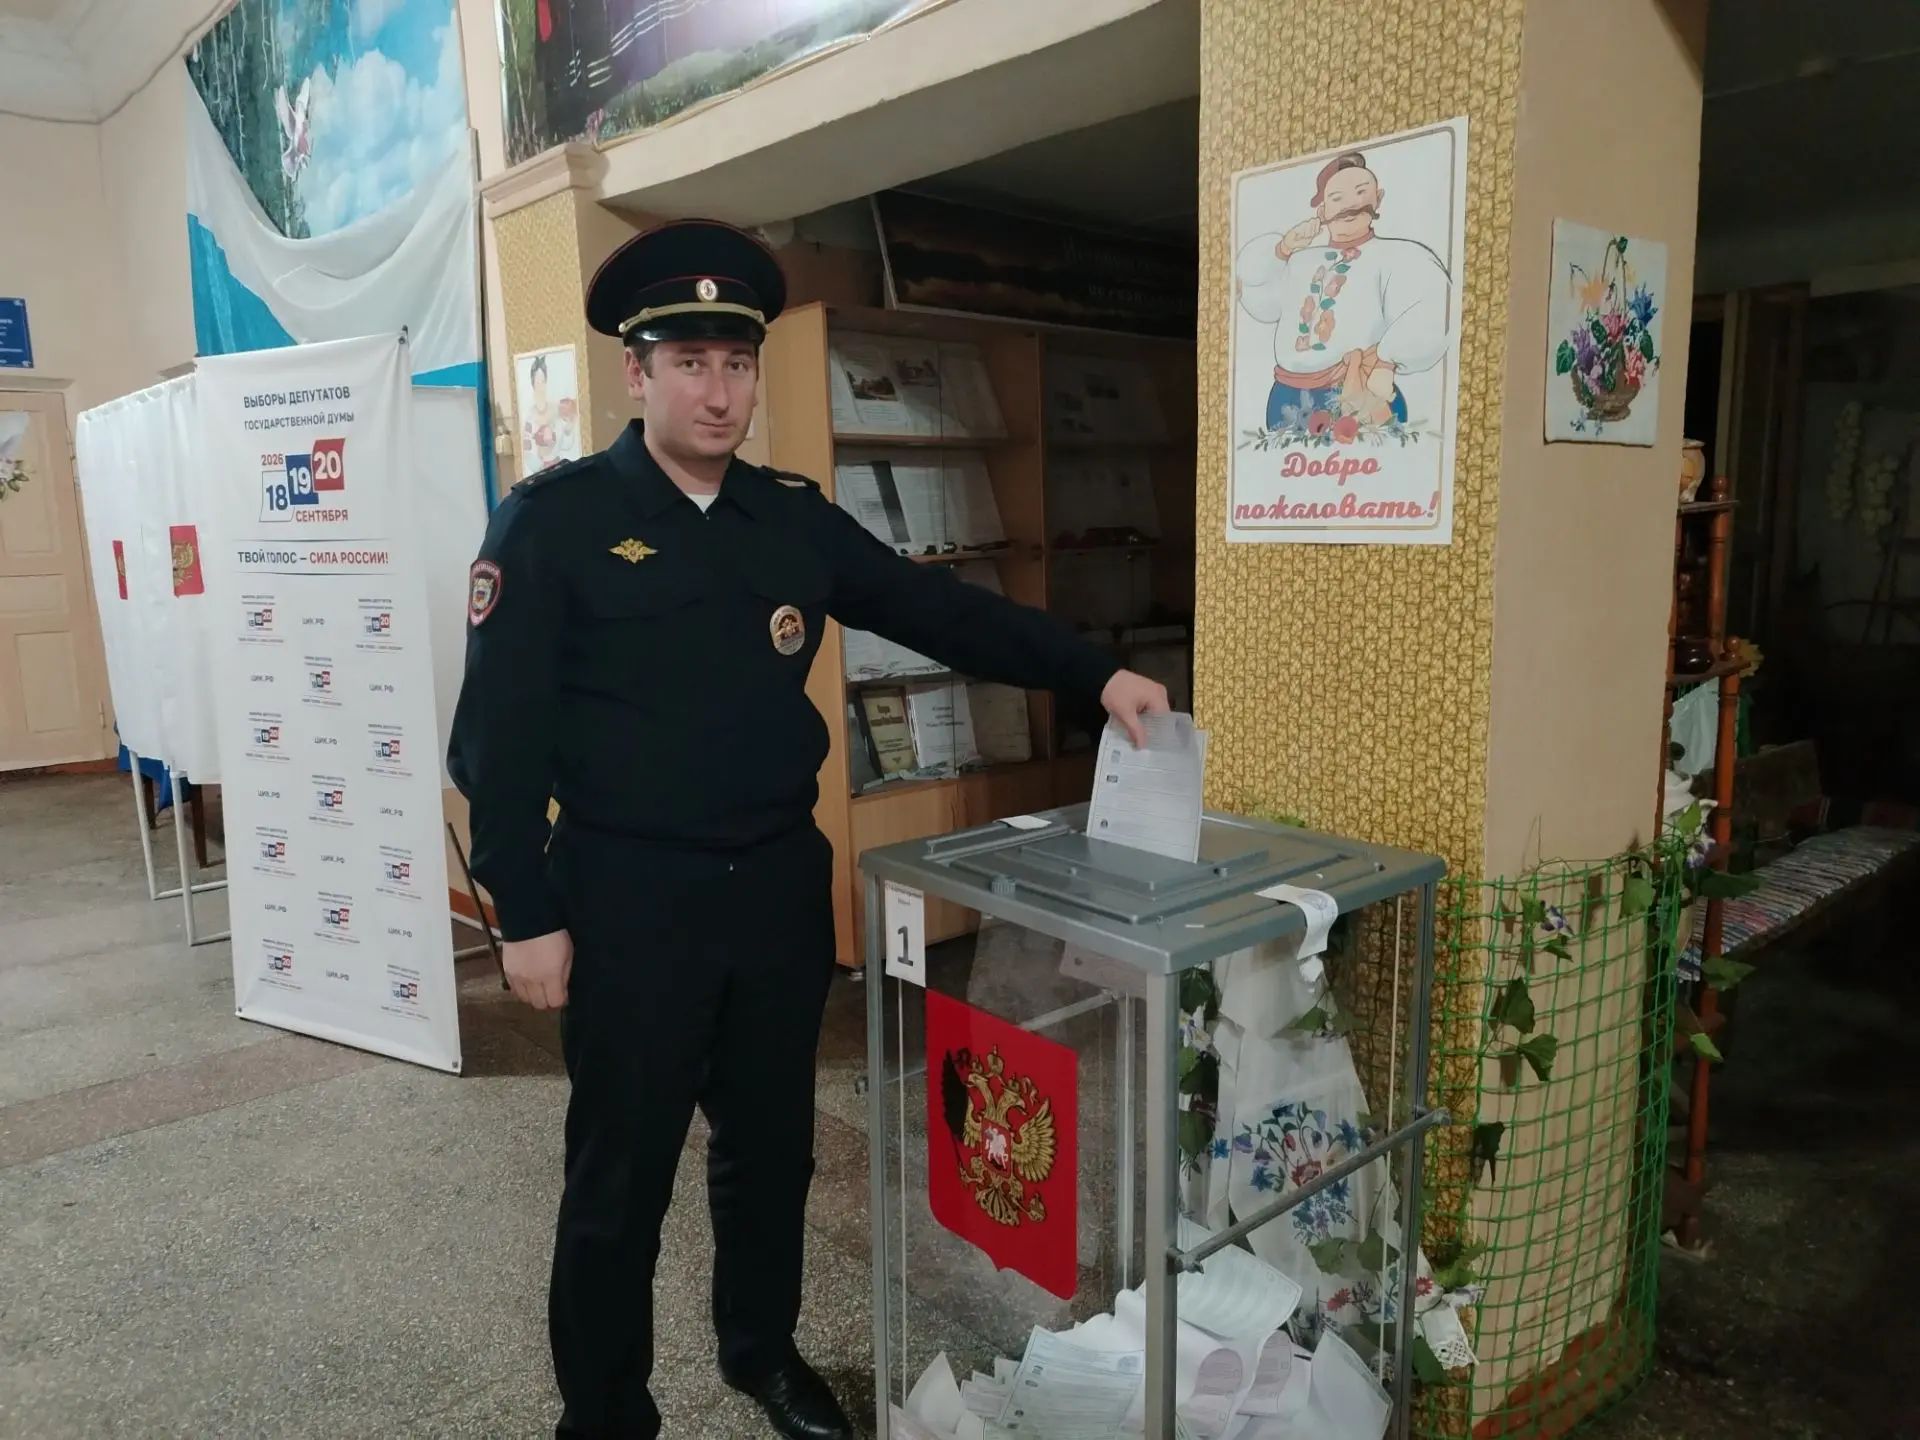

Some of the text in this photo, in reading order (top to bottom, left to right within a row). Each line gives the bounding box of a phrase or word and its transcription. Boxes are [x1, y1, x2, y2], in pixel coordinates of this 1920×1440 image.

[244, 386, 351, 408] ВЫБОРЫ ДЕПУТАТОВ
[244, 412, 355, 430] ГОСУДАРСТВЕННОЙ ДУМЫ
[261, 453, 284, 466] 2026
[313, 450, 342, 480] 20
[1280, 450, 1382, 486] Добро
[289, 466, 312, 495] 19
[265, 484, 288, 511] 18
[1235, 491, 1440, 520] пожаловать!
[295, 509, 348, 522] СЕНТЯБРЯ
[238, 549, 266, 564] ТВОЙ
[267, 551, 297, 564] ГОЛОС
[309, 551, 338, 564] СИЛА
[340, 551, 389, 564] РОССИИ!
[897, 926, 914, 968] 1
